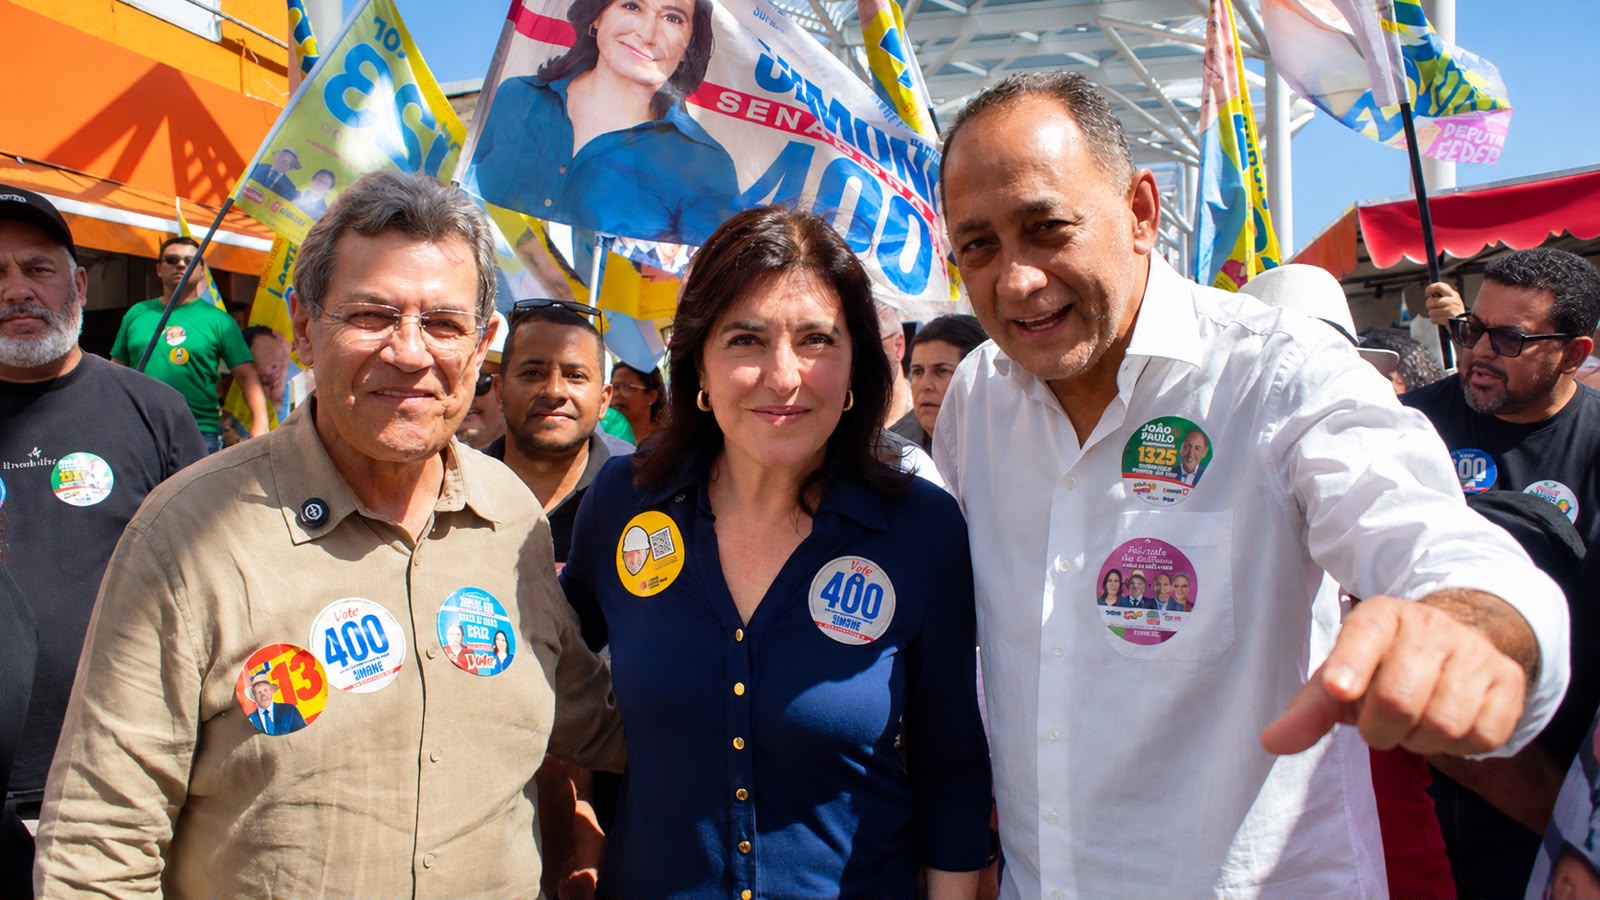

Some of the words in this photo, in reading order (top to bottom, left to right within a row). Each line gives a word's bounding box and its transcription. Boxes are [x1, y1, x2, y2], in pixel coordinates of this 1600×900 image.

[1140, 432, 1175, 443] PAULO
[1138, 446, 1177, 466] 1325
[1453, 456, 1487, 480] 00
[850, 560, 873, 576] Vote
[820, 571, 884, 620] 400
[333, 607, 359, 622] Vote
[324, 614, 390, 668] 400
[271, 654, 323, 706] 13
